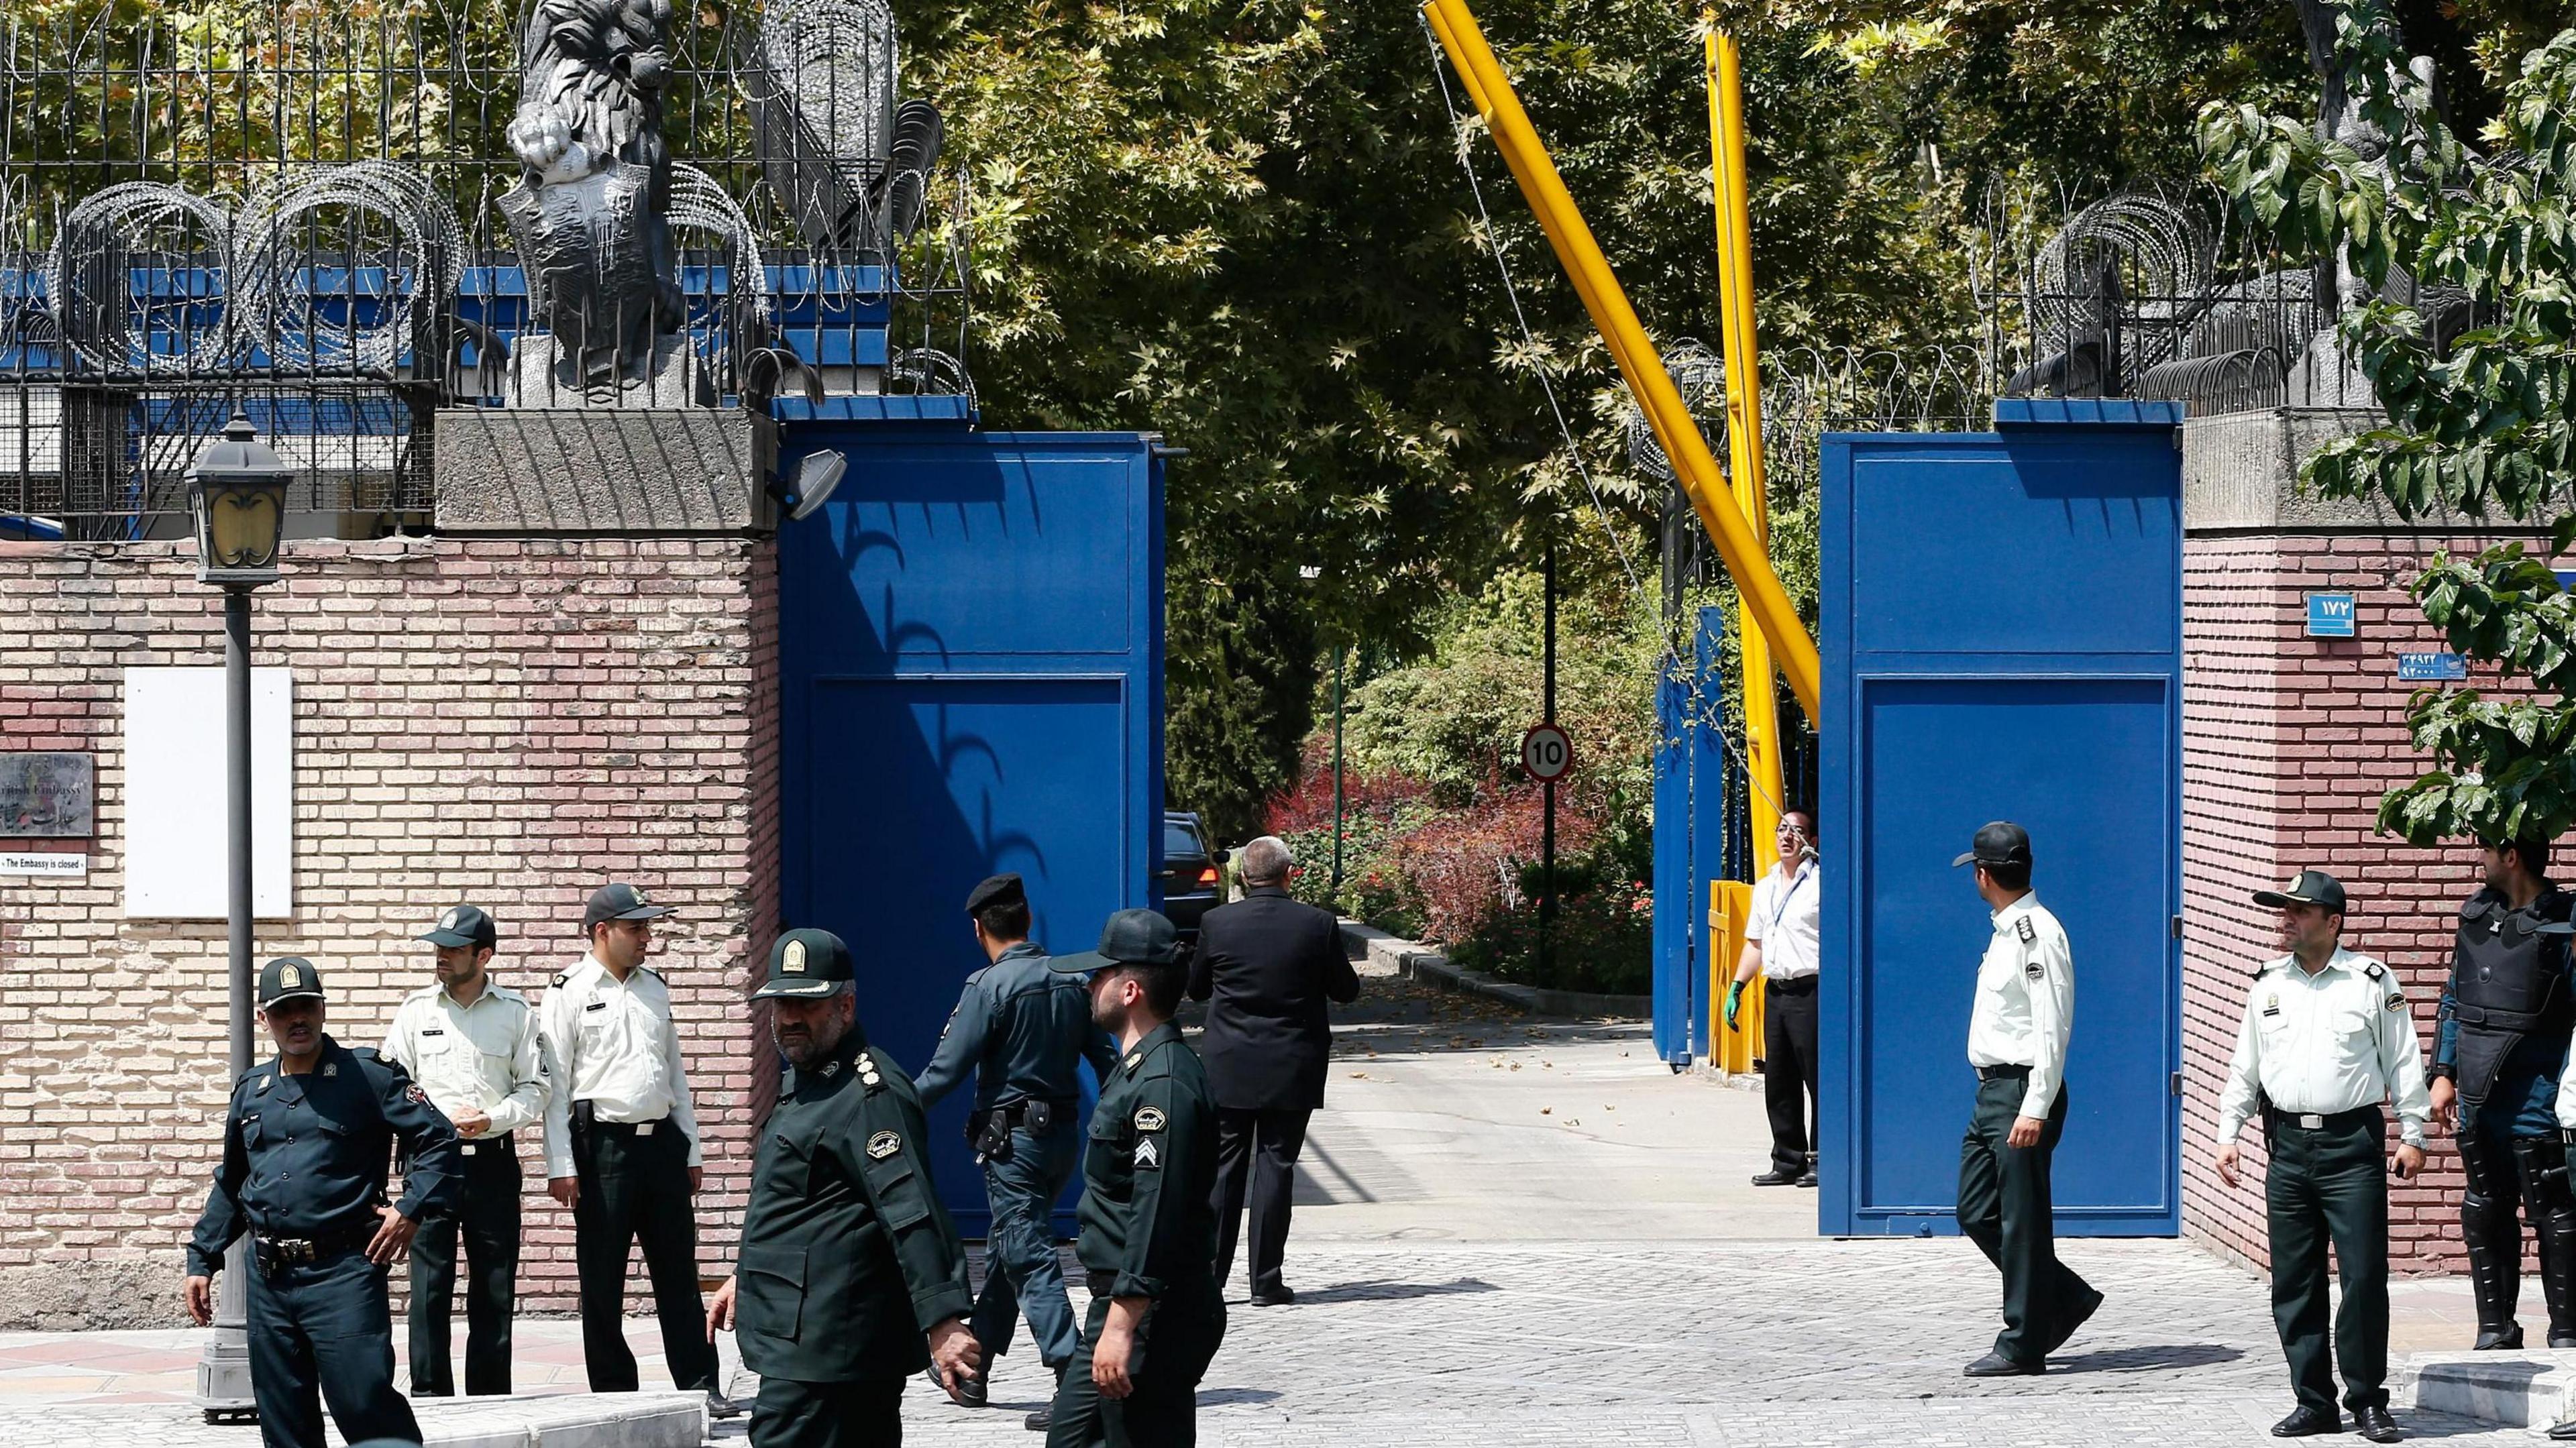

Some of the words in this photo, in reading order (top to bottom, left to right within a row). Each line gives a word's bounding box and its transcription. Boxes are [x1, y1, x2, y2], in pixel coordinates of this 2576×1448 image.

[2322, 601, 2349, 616] ۱۷۲
[1533, 741, 1562, 765] 10
[0, 783, 30, 795] ritish
[6, 858, 18, 867] The
[20, 858, 48, 870] Embassy
[50, 859, 56, 868] is
[58, 859, 78, 869] closed
